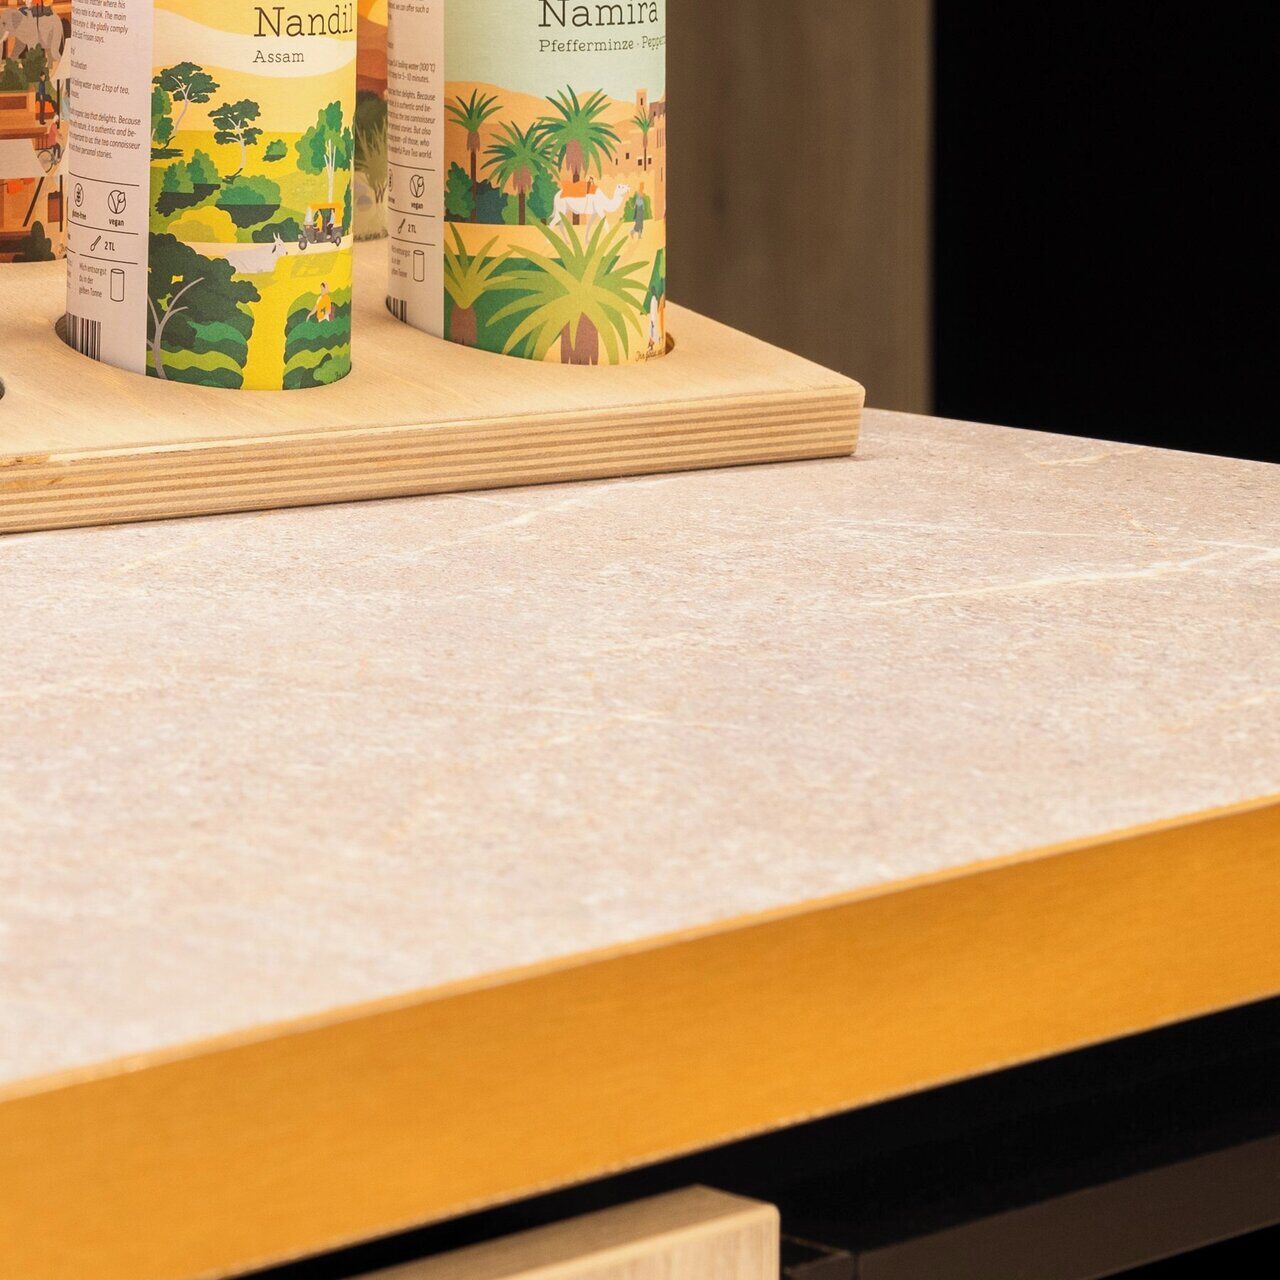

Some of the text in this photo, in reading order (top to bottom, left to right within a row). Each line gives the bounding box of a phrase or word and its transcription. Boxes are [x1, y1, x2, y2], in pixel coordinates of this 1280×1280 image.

[110, 24, 129, 35] comply
[539, 38, 634, 53] Pfefferminze
[252, 50, 305, 63] Assam
[118, 115, 142, 126] Because
[109, 140, 141, 150] connoisseur
[411, 202, 424, 210] vegan
[109, 218, 125, 227] vegan
